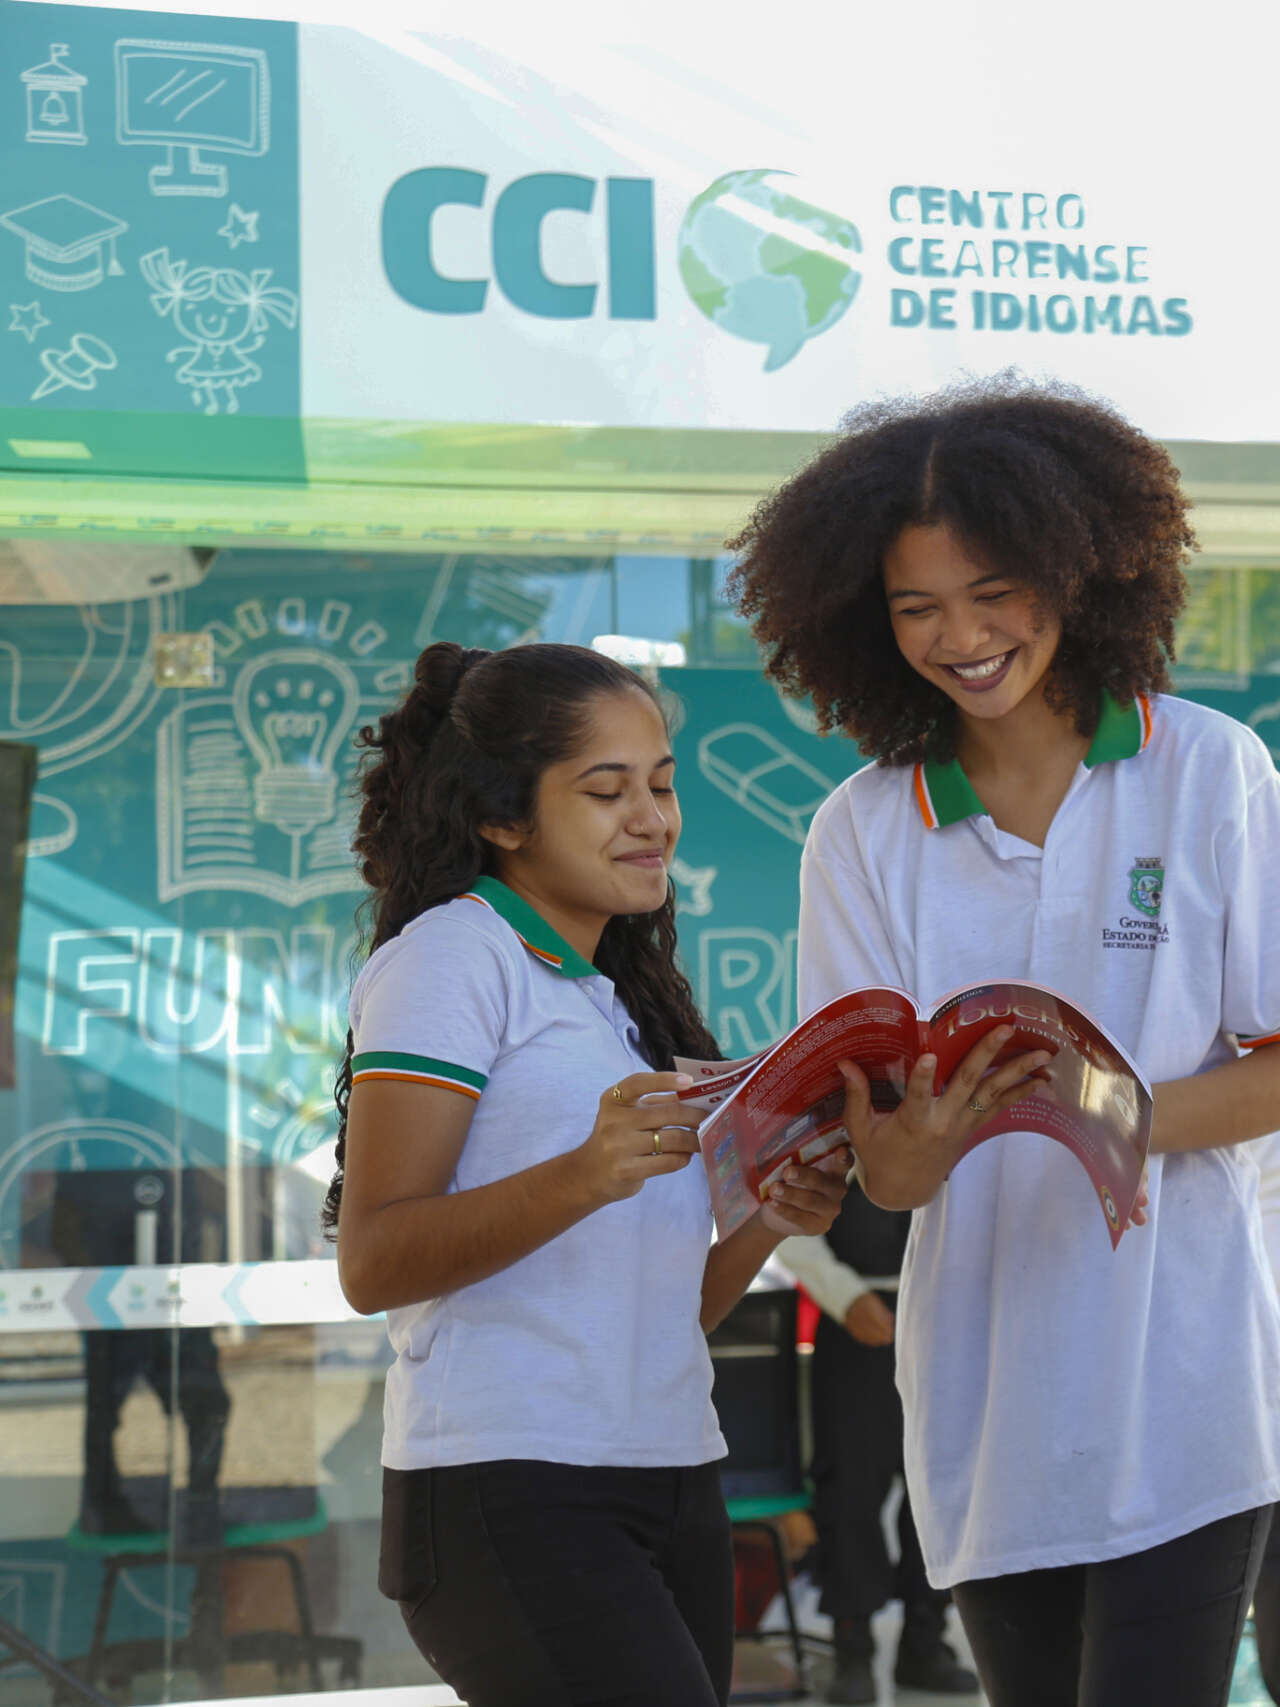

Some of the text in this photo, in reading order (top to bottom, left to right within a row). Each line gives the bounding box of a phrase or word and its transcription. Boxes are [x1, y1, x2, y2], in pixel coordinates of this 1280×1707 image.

[889, 185, 1085, 231] CENTRO
[381, 165, 657, 321] CCI
[887, 236, 1149, 283] CEARENSE
[890, 288, 1193, 337] DE IDIOMAS
[1103, 929, 1147, 941] ESTADO
[1119, 916, 1160, 930] GOVER
